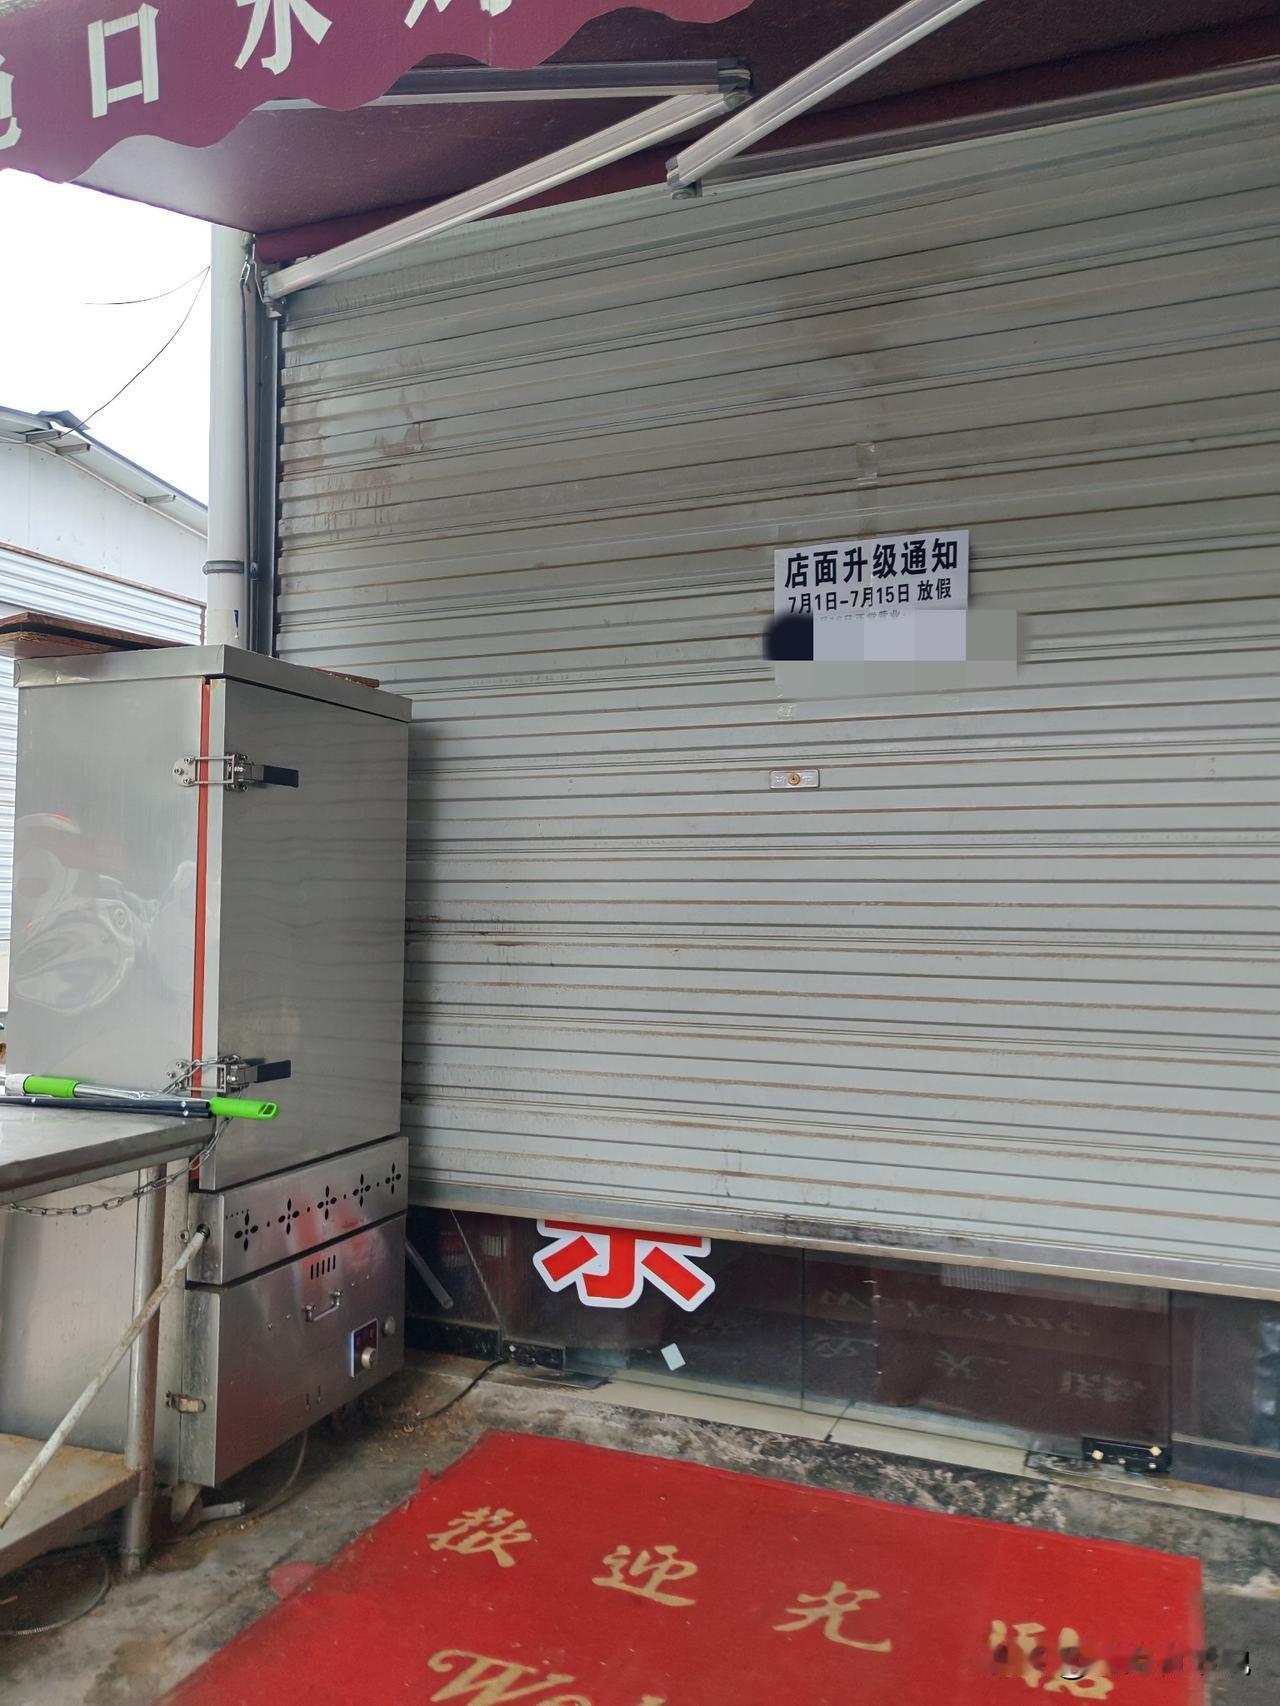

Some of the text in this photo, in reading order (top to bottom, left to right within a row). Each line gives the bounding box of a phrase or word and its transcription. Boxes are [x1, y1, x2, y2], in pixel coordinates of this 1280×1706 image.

[785, 538, 958, 588] 店面升级通知
[788, 577, 952, 614] 7月1日-7月15日 放假
